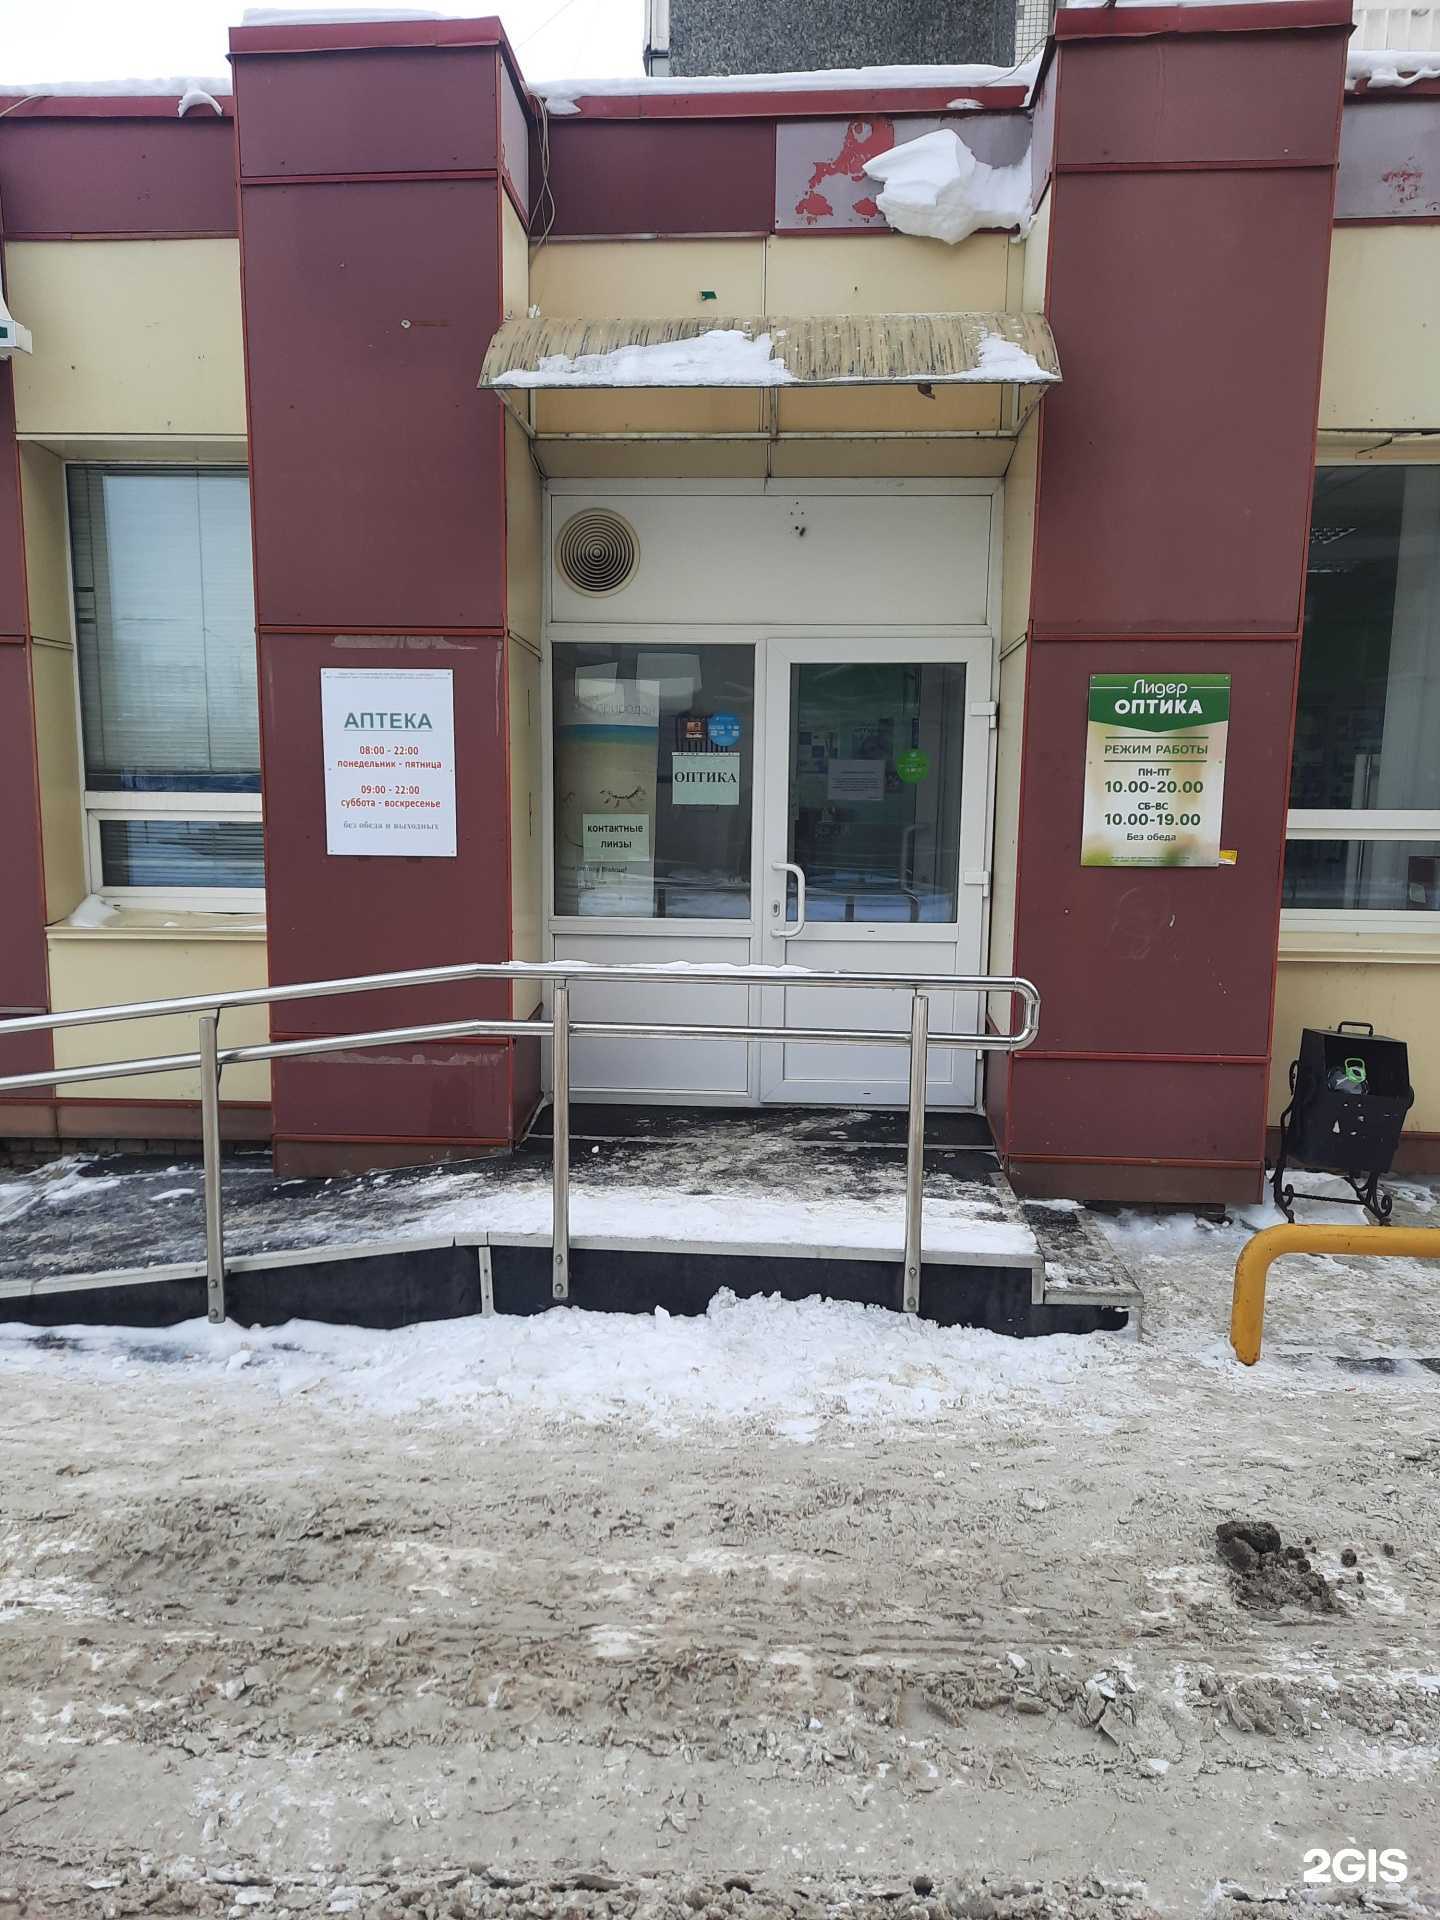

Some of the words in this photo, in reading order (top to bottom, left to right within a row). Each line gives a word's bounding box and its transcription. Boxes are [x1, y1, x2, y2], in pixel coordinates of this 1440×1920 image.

[1132, 679, 1188, 698] Лидер
[1114, 699, 1203, 715] ОПТИКА
[344, 712, 433, 729] АПТЕКА
[359, 746, 385, 756] 08:00
[393, 746, 419, 756] 22:00
[1104, 744, 1151, 755] РЕЖИМ
[1156, 744, 1208, 755] РАБОТЫ
[337, 760, 396, 769] понедельник
[405, 761, 442, 770] пятница
[674, 771, 737, 784] ОПТИКА
[361, 785, 386, 795] 09:00
[395, 785, 420, 795] 22:00
[1104, 780, 1204, 794] 10.00-20.00
[340, 797, 376, 808] суббота
[384, 800, 441, 809] воскресенье
[1104, 813, 1201, 826] 10.00-19.00
[587, 823, 644, 834] контактные
[1126, 832, 1144, 841] Без
[1146, 832, 1177, 842] обеда
[600, 839, 632, 850] линзы
